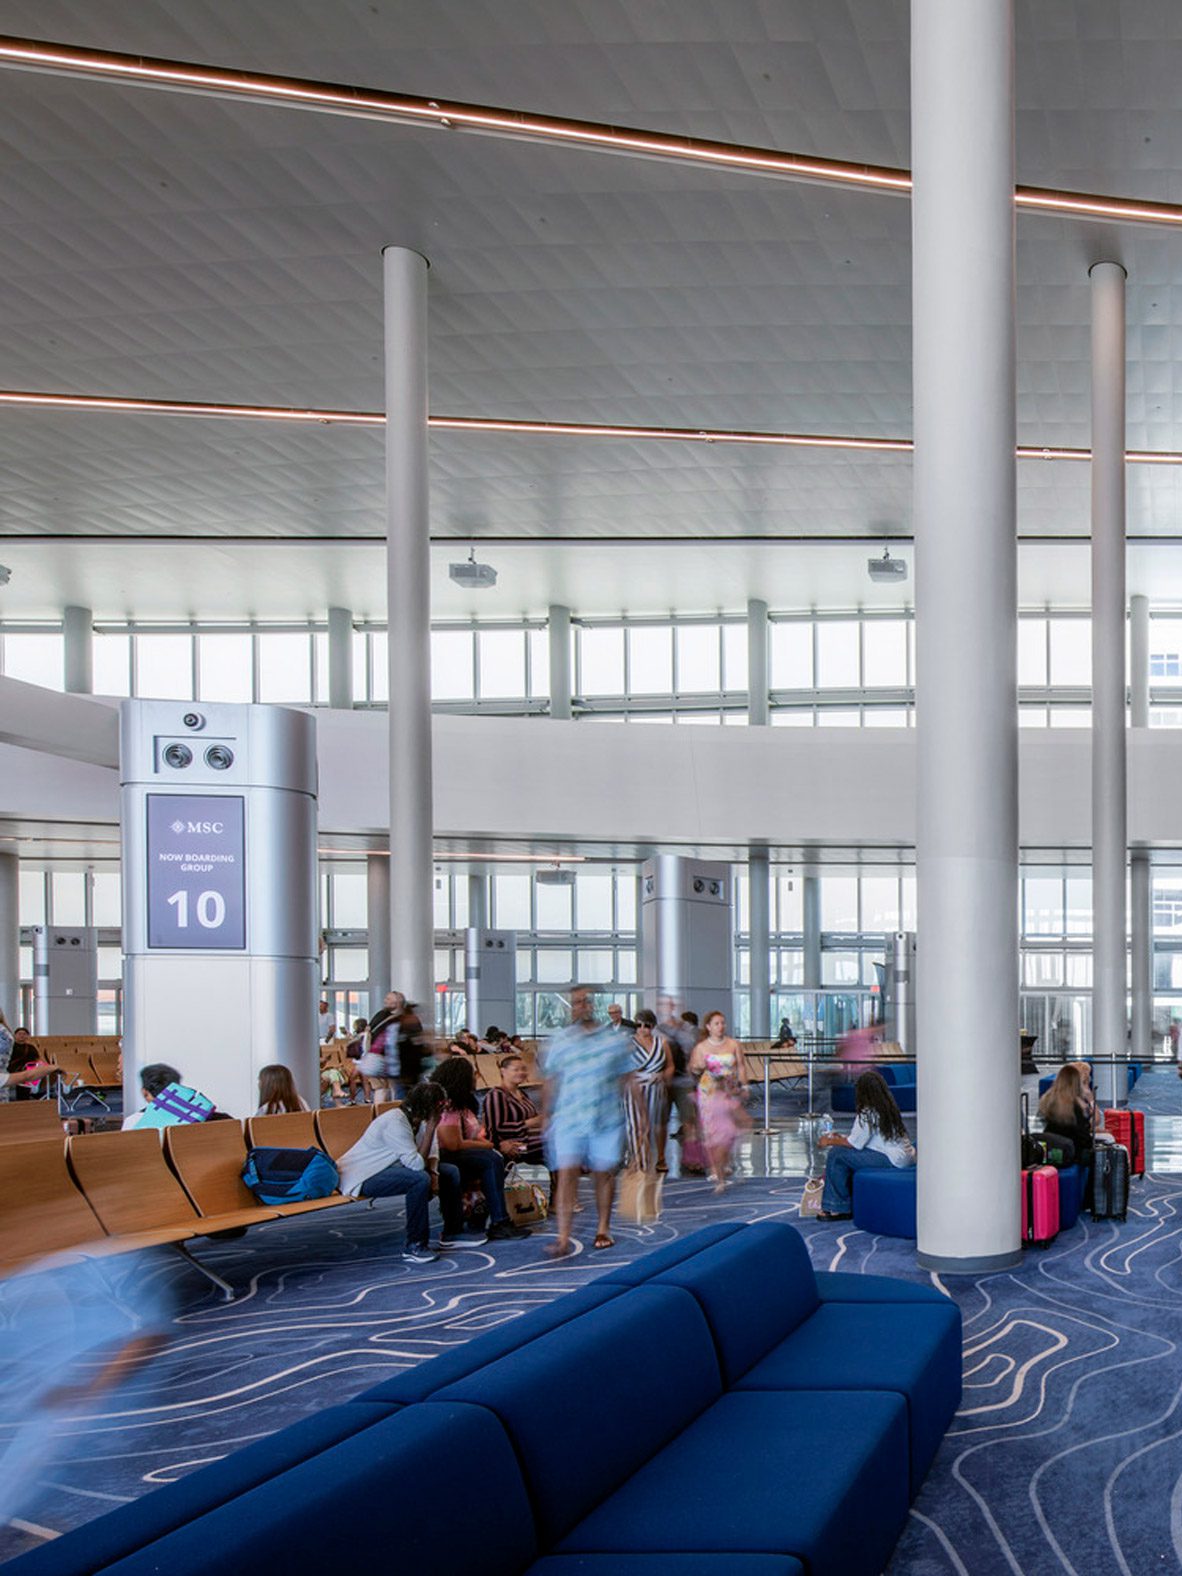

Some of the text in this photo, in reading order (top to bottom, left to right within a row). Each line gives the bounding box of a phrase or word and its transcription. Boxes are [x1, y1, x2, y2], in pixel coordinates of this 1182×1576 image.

[187, 822, 224, 834] MSC
[159, 853, 235, 863] NOW BOARDING
[180, 863, 214, 872] GROUP
[167, 890, 225, 929] 10
